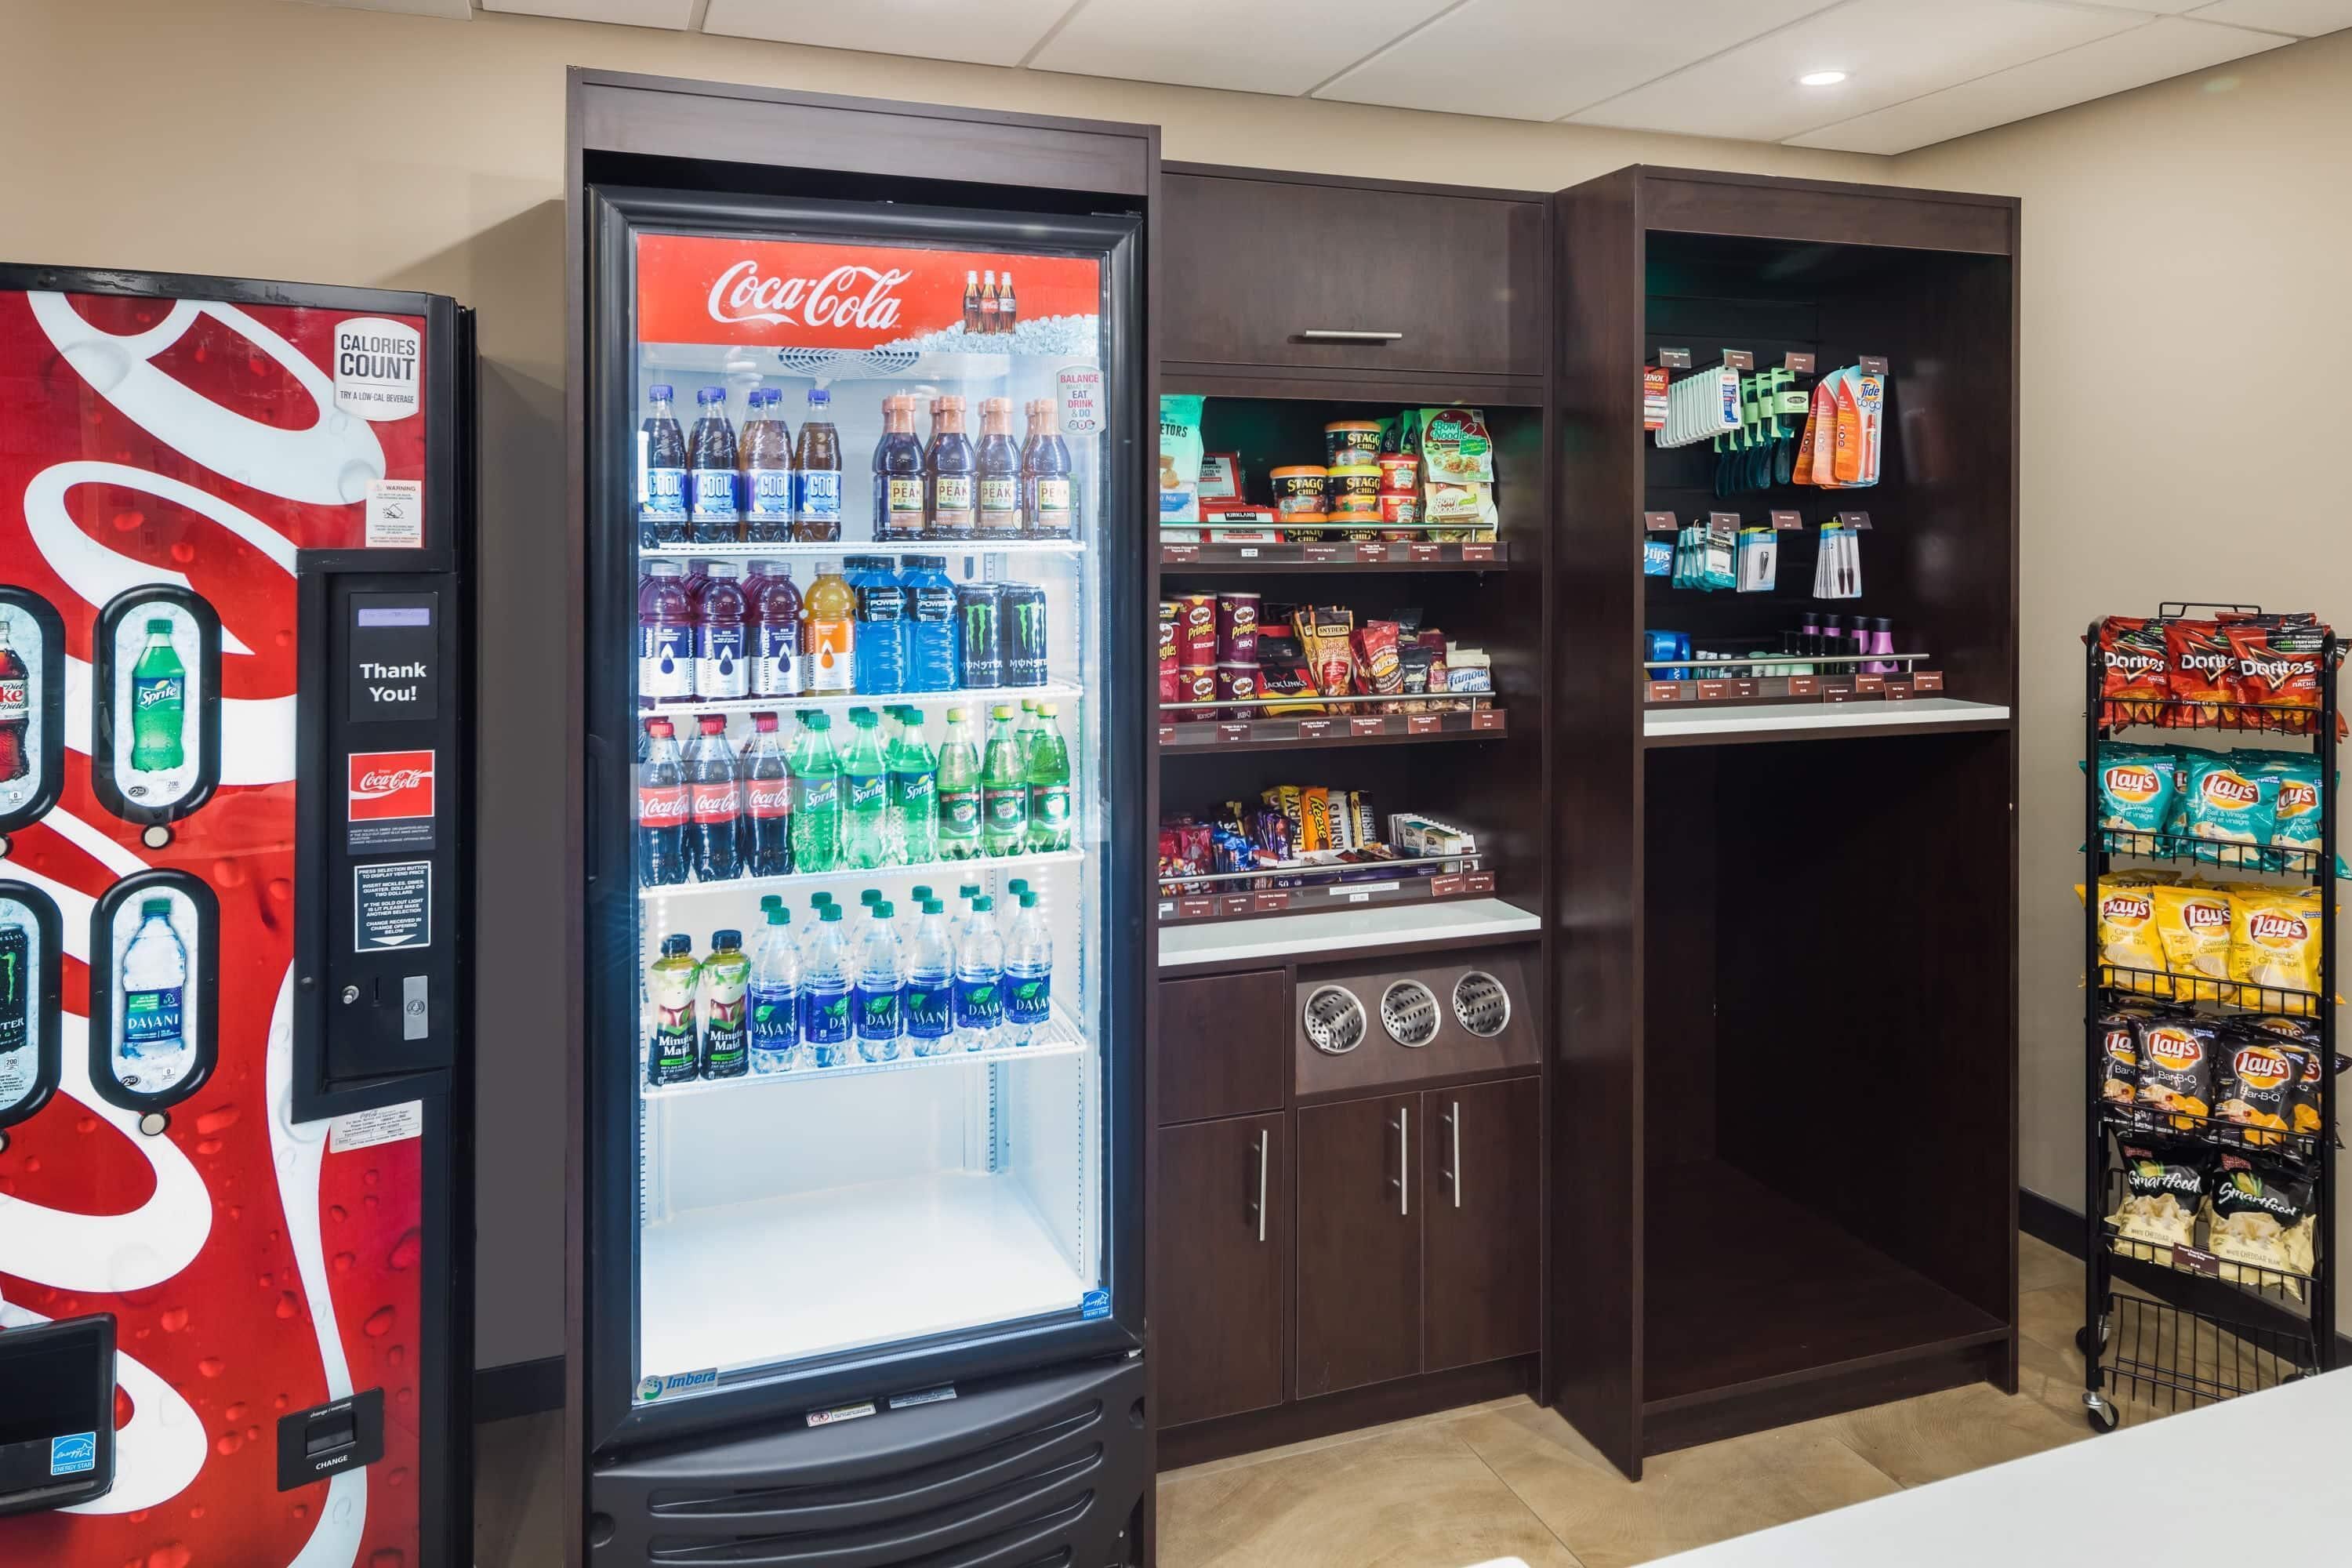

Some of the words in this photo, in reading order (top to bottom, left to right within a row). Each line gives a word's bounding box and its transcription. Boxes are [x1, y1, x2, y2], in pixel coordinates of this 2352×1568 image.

[708, 260, 913, 329] Coca-Cola
[340, 334, 416, 356] CALORIES
[340, 353, 415, 381] COUNT
[1060, 374, 1099, 383] BALANCE
[340, 390, 352, 401] TRY
[354, 392, 358, 401] A
[359, 393, 386, 402] LOW-CAL
[387, 394, 414, 404] BEVERAGE
[1072, 390, 1087, 399] EAT
[1861, 383, 1880, 398] Tide
[1067, 400, 1094, 408] DRINK
[1857, 396, 1868, 407] to
[1868, 400, 1882, 412] go
[1079, 408, 1091, 417] DO
[1160, 423, 1188, 438] ETORS
[1432, 420, 1462, 431] Bowl
[1348, 433, 1381, 446] STAGG
[1432, 430, 1468, 441] Noodle
[648, 474, 680, 498] COOL
[699, 474, 730, 498] COOL
[760, 474, 790, 498] COOL
[982, 487, 1012, 497] PEAK
[1287, 478, 1323, 492] STAGG
[1346, 477, 1381, 491] STAGG
[1188, 622, 1215, 641] Pringles
[1231, 622, 1258, 641] Pringles
[1238, 639, 1254, 648] BBQ
[2103, 652, 2165, 672] Doritos
[2240, 660, 2315, 677] Doritos
[360, 662, 426, 679] Thank
[1447, 669, 1488, 688] Famous
[1263, 681, 1283, 690] JACK
[0, 686, 24, 702] ke
[140, 684, 177, 707] Sprite
[369, 686, 417, 702] You!
[1236, 710, 1252, 720] BBQ
[2111, 770, 2157, 792] Lay's
[2205, 774, 2256, 800] Lay's
[854, 783, 885, 804] Sprite
[906, 780, 935, 800] Sprite
[2188, 904, 2230, 927] Lay's
[2256, 914, 2306, 939] Lay's
[128, 1014, 178, 1029] DASANI
[658, 1034, 694, 1047] Minute
[710, 1029, 743, 1041] Minute
[663, 1043, 691, 1056] Maid
[714, 1038, 740, 1051] Maid
[2153, 1033, 2198, 1059] Lay's
[2238, 1052, 2287, 1078] Lay's
[2127, 1170, 2202, 1193] Smartfood
[2219, 1182, 2298, 1216] Smartfood
[666, 1370, 716, 1390] Imbera
[315, 1454, 348, 1470] CHANGE
